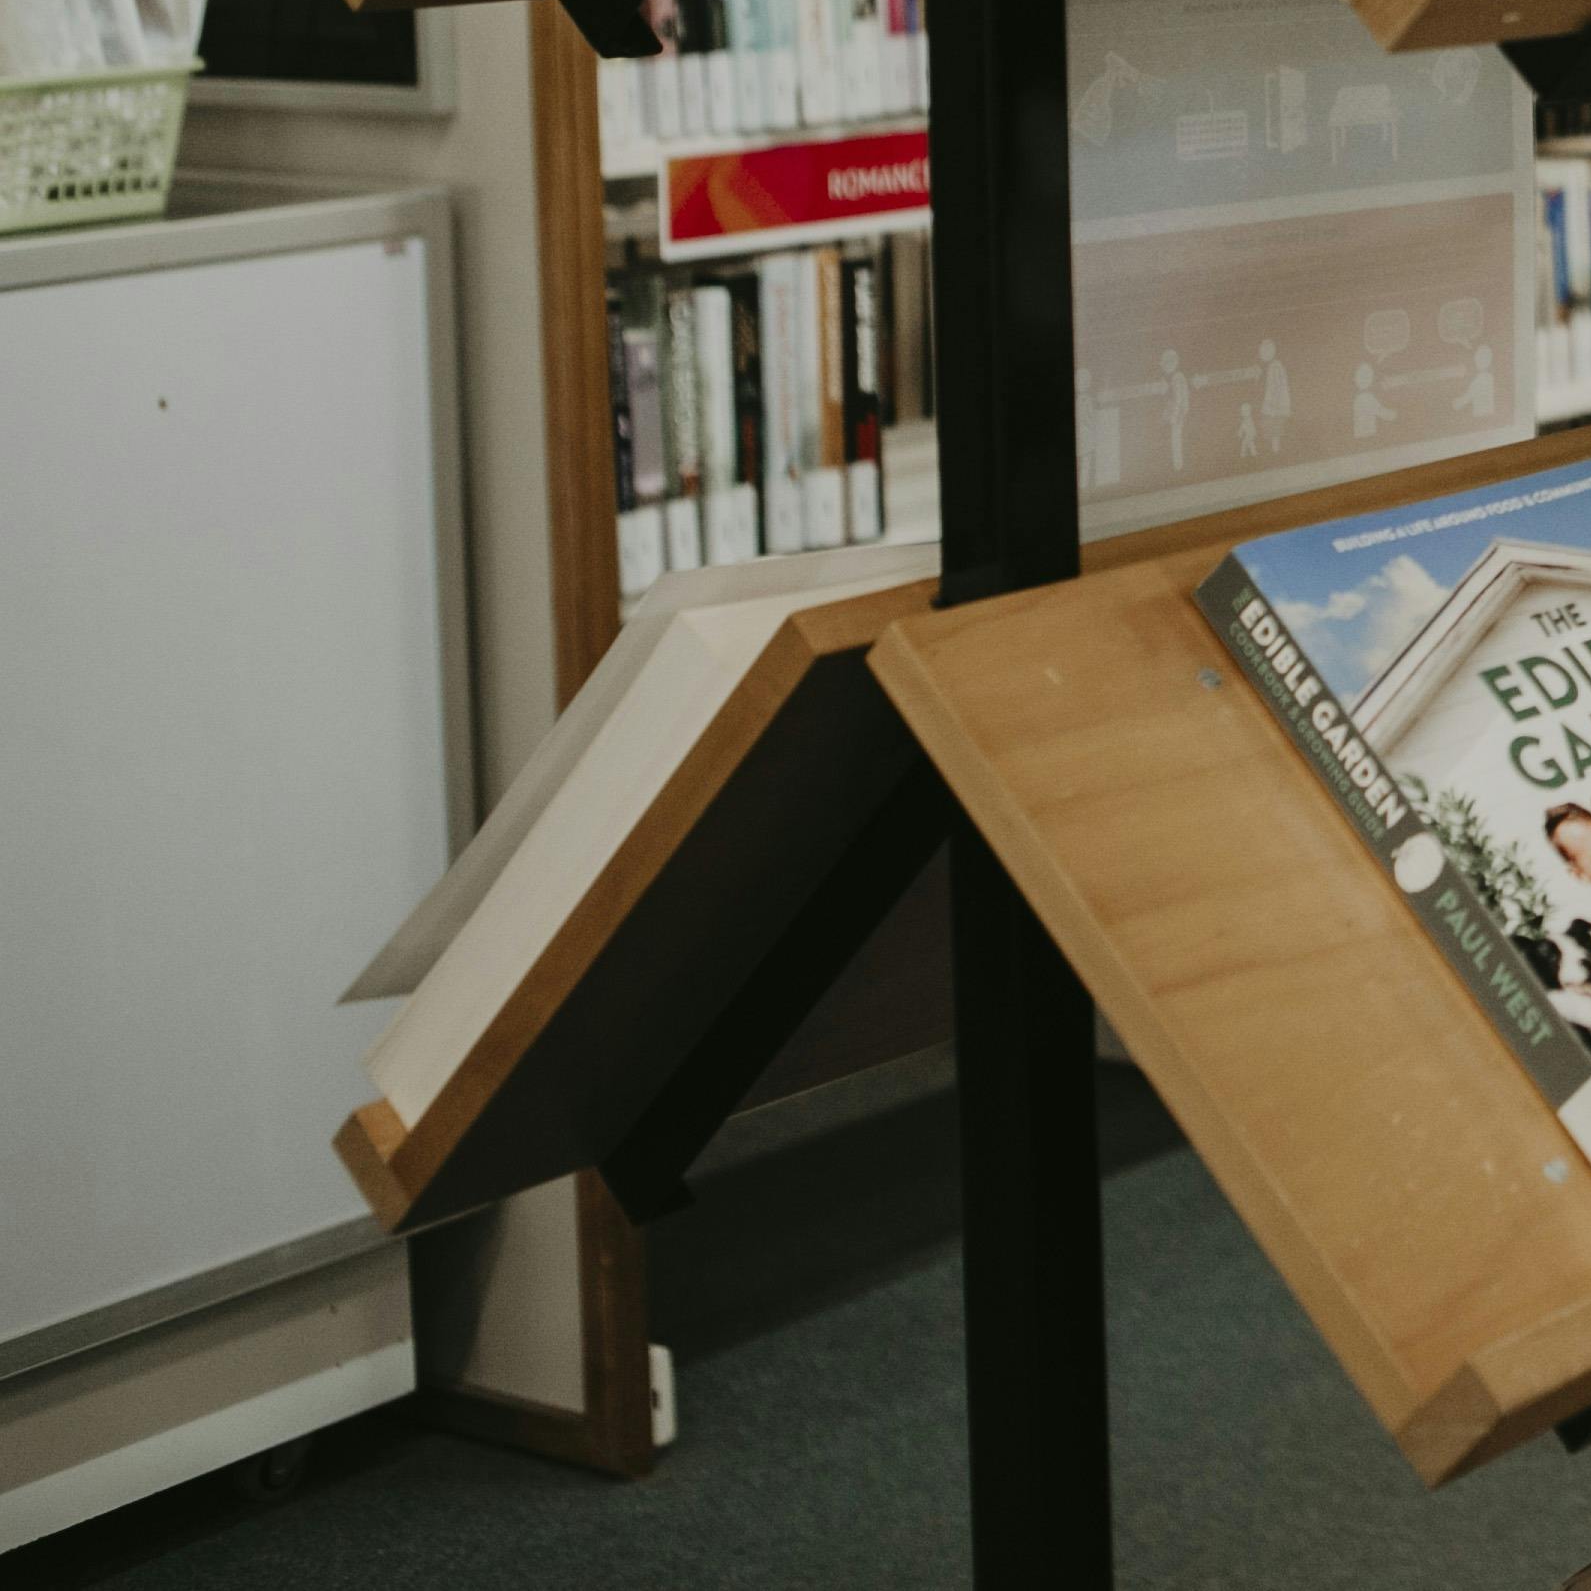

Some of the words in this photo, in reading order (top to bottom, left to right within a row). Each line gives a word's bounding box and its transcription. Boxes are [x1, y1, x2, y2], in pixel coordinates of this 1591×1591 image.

[1530, 603, 1588, 639] THE
[1229, 621, 1291, 707] COOKBOOK
[1297, 719, 1350, 792] GROWING
[1239, 597, 1323, 708] EDIBLE
[1312, 699, 1408, 830] GARDEN
[1433, 891, 1493, 971] PAUL
[1489, 966, 1553, 1048] WEST
